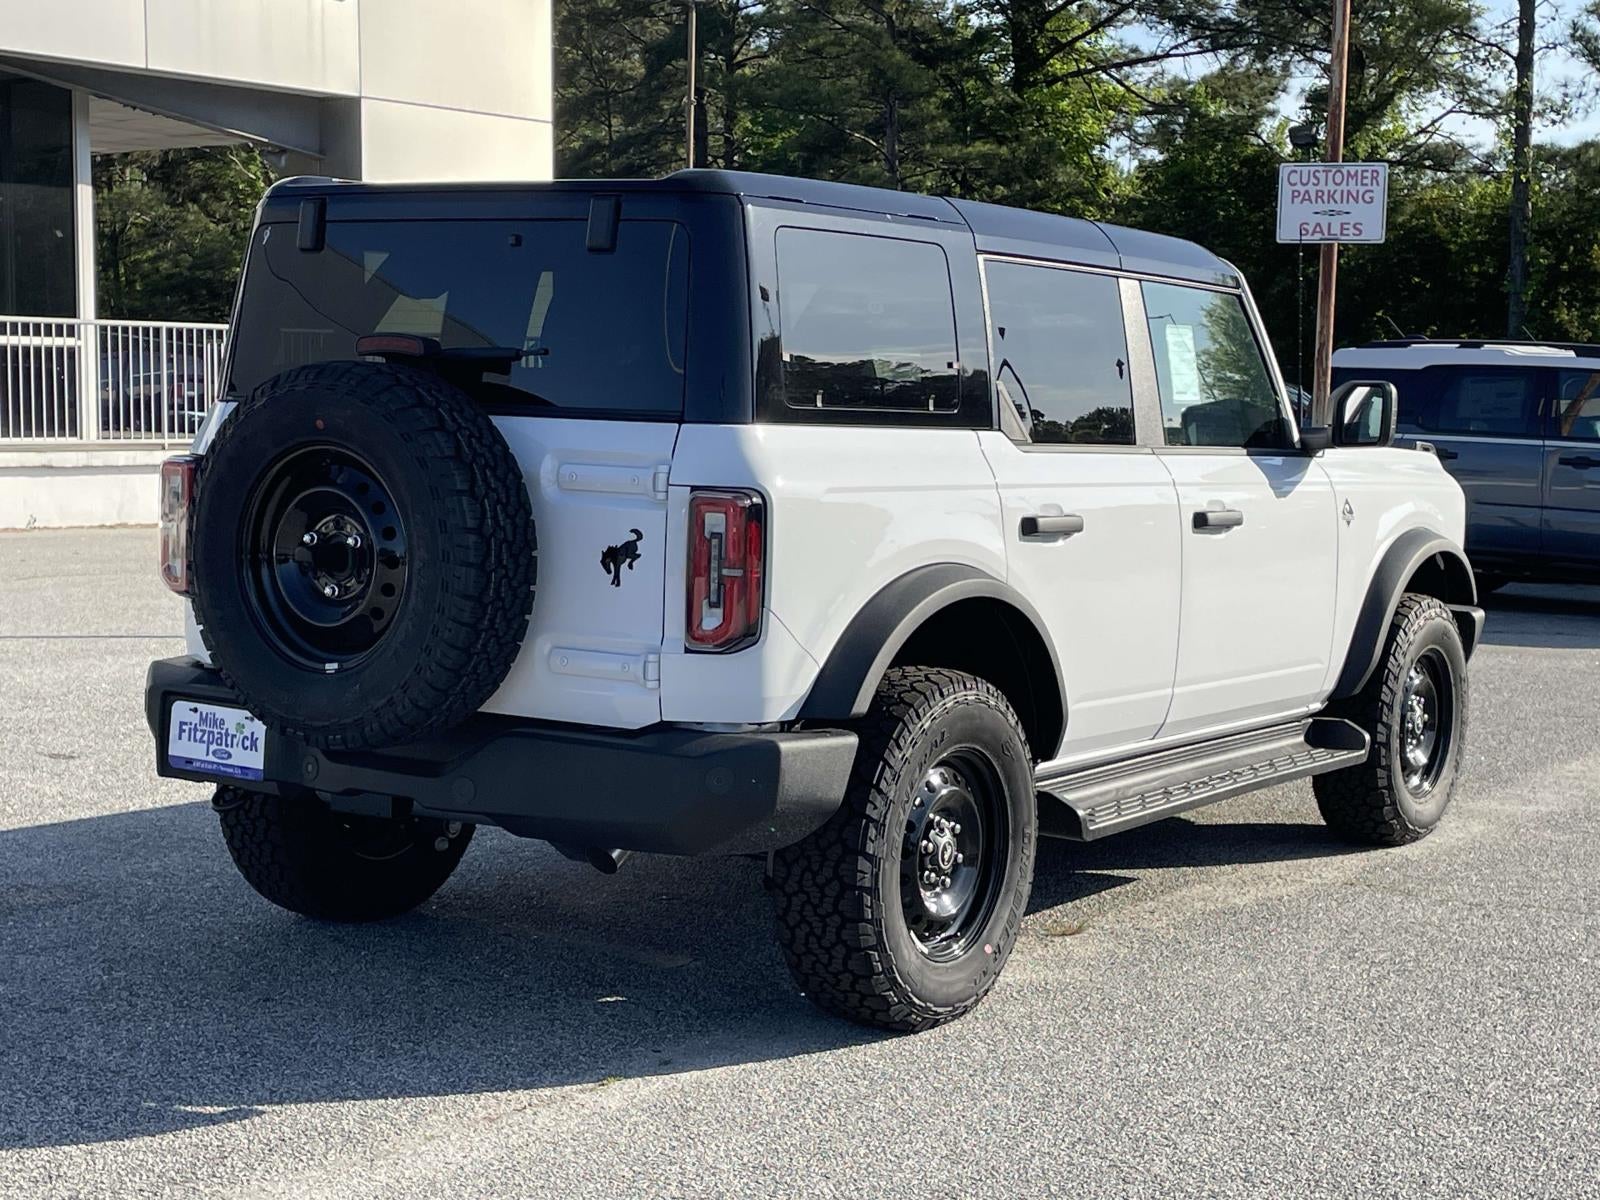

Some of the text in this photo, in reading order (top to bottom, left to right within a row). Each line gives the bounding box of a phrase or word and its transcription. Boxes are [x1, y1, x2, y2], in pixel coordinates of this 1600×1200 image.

[1287, 169, 1380, 187] CUSTOMER
[1291, 189, 1375, 205] PARKING
[1299, 222, 1363, 237] SALES
[199, 711, 225, 731] Mike
[178, 720, 259, 757] Fitzpatrick
